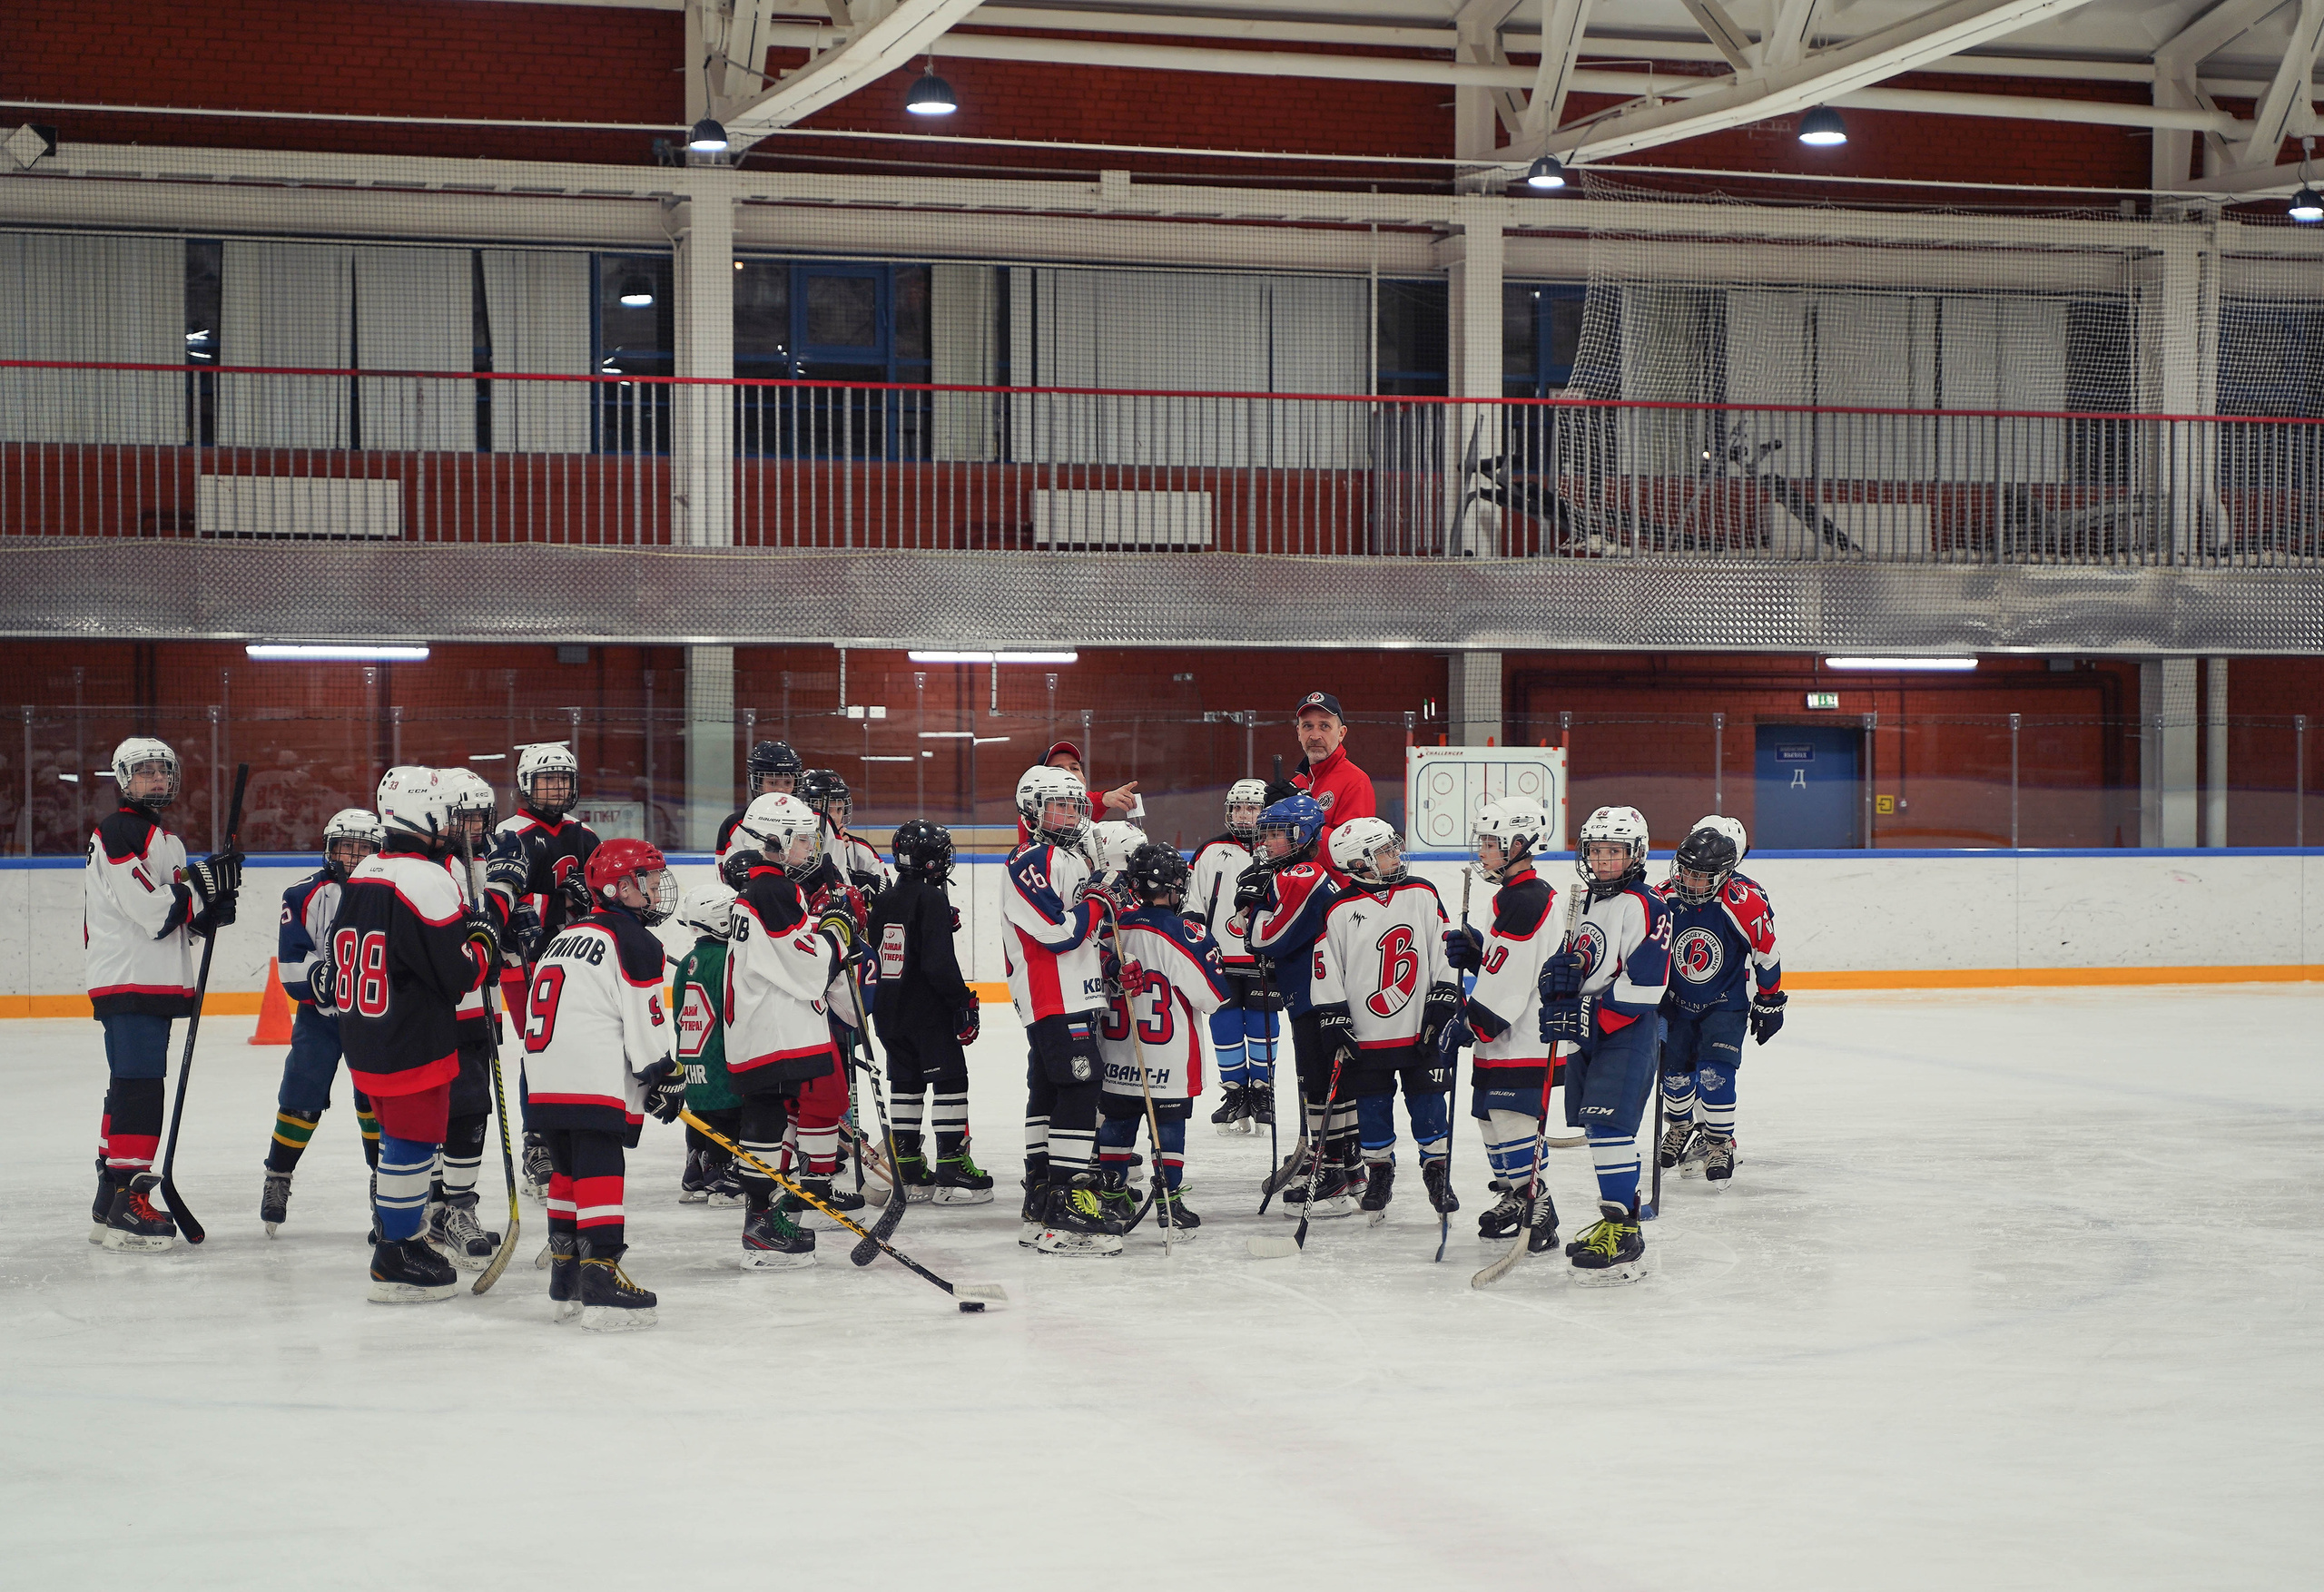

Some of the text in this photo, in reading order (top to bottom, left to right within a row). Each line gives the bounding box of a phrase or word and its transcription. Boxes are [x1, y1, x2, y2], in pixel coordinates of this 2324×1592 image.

[388, 781, 399, 791] 33
[1790, 769, 1807, 789] Д
[333, 927, 389, 1018] 88
[1676, 945, 1685, 967] VIKHR
[1702, 934, 1718, 949] CLUB
[1710, 950, 1721, 970] VIKHR
[524, 964, 566, 1054] 9
[851, 1083, 861, 1139] BAUER
[1579, 1106, 1615, 1116] CCM
[704, 1124, 871, 1241] FRONTIER
[1304, 1174, 1318, 1221] BAUER
